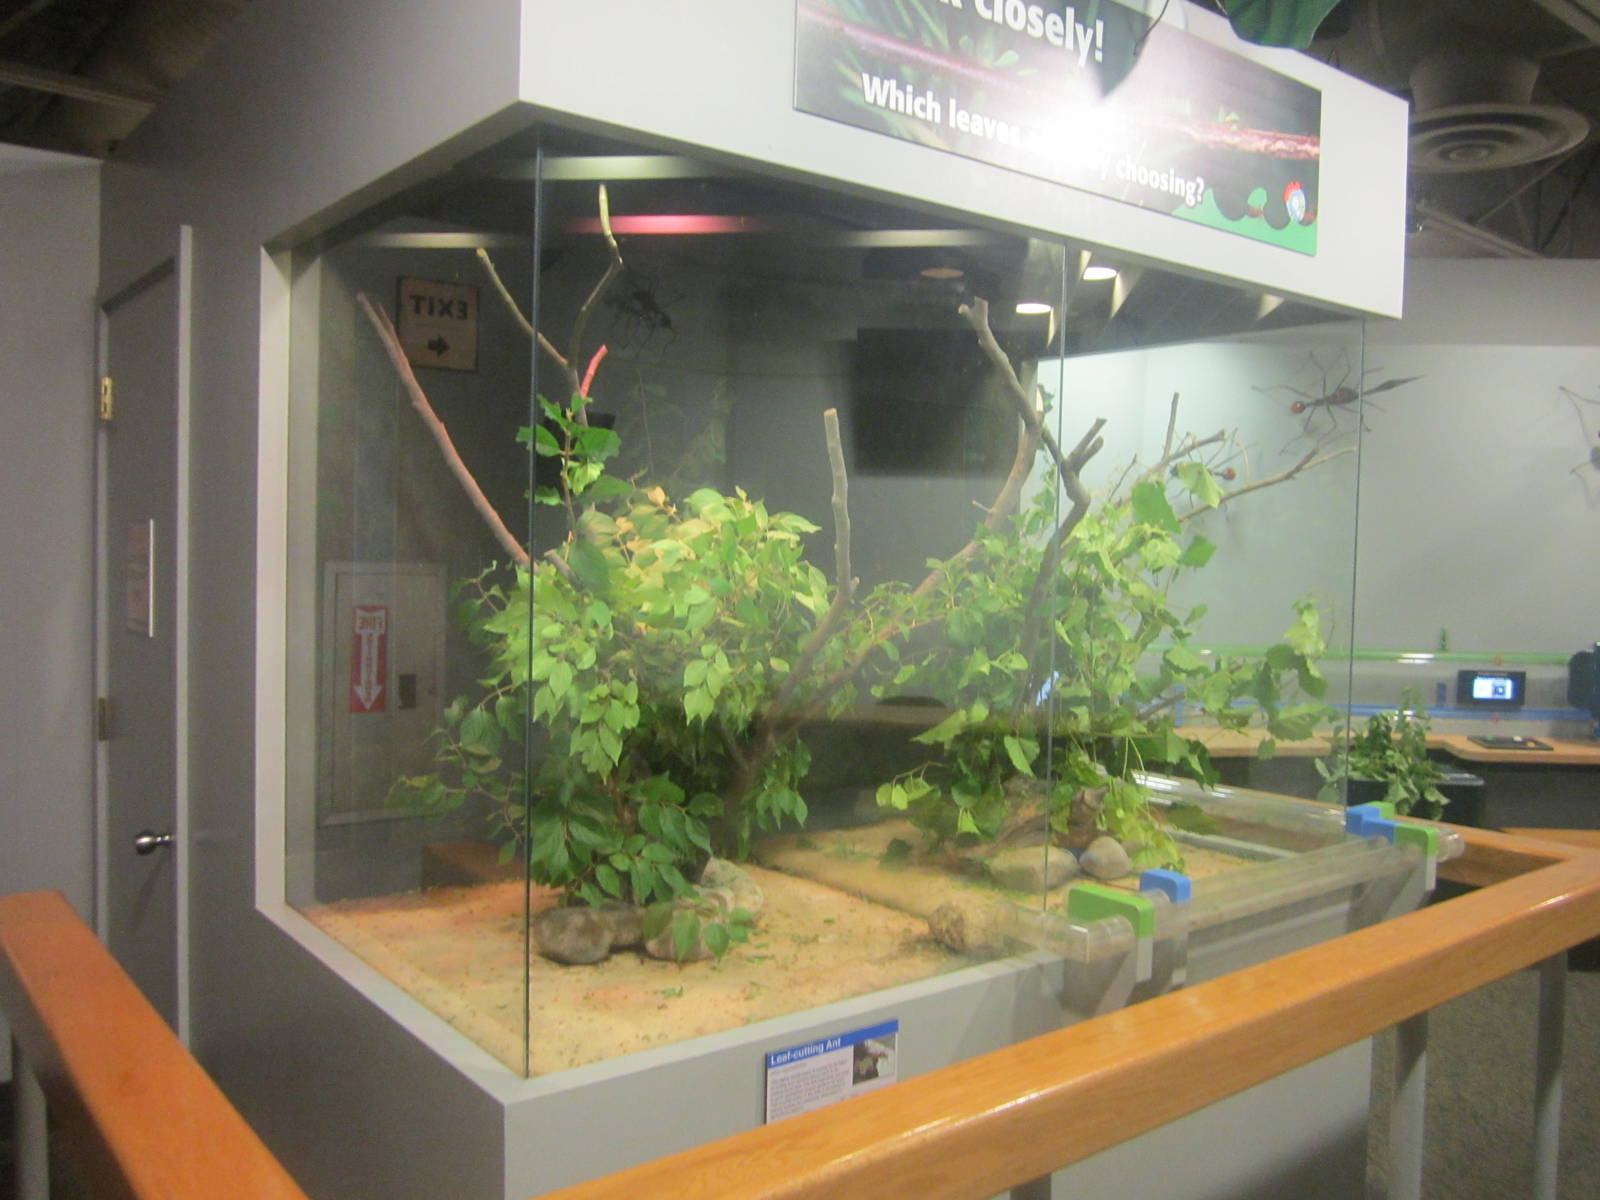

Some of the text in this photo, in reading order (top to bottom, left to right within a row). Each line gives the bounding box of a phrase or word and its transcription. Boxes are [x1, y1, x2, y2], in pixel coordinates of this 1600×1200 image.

[861, 72, 941, 124] Which
[1115, 152, 1204, 207] choosing?
[771, 1038, 841, 1065] Leaf-cutting Ant
